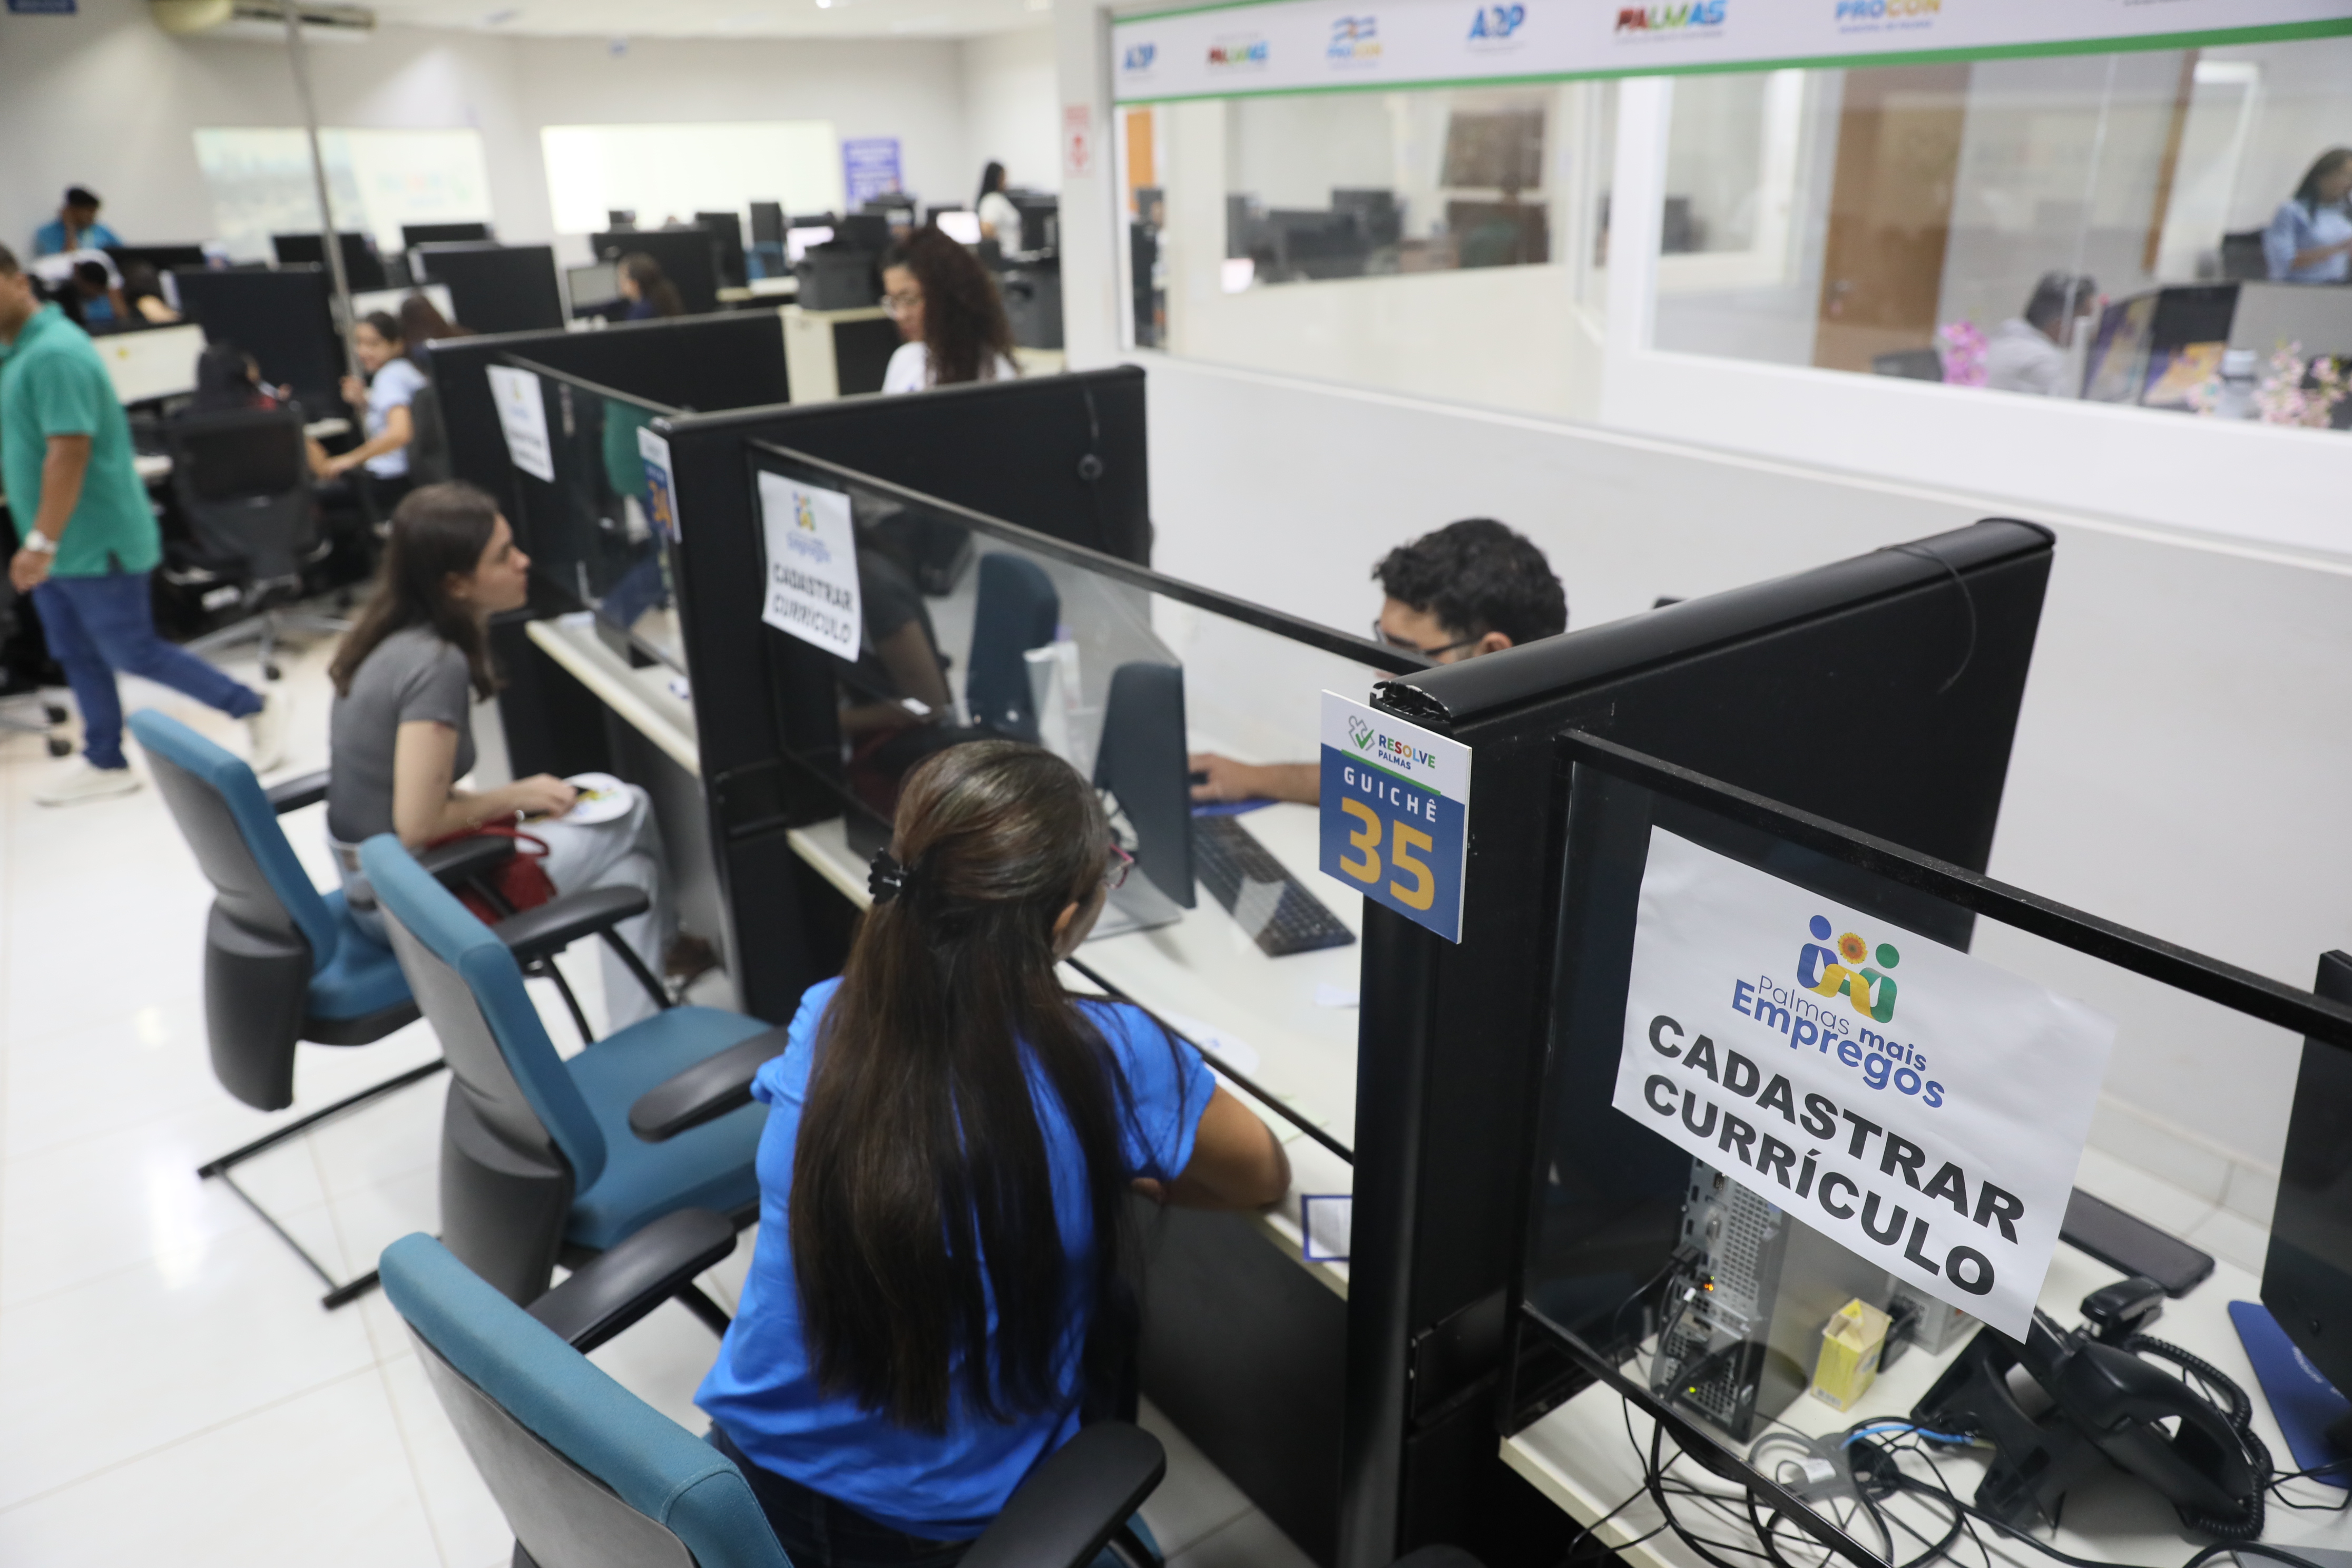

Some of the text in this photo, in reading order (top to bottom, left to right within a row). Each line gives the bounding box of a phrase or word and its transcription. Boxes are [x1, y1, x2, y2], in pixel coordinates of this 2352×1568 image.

[1614, 0, 1728, 33] PALMAS
[1344, 766, 1437, 822] GUICHÊ
[1378, 734, 1436, 769] RESOLVE
[1378, 749, 1411, 770] PALMAS
[1339, 796, 1435, 911] 35
[1732, 978, 1945, 1109] Empregos
[1759, 975, 1927, 1072] Palmas mais
[1648, 1014, 2025, 1245] CADASTRAR
[1643, 1074, 1995, 1296] CURRÍCULO
